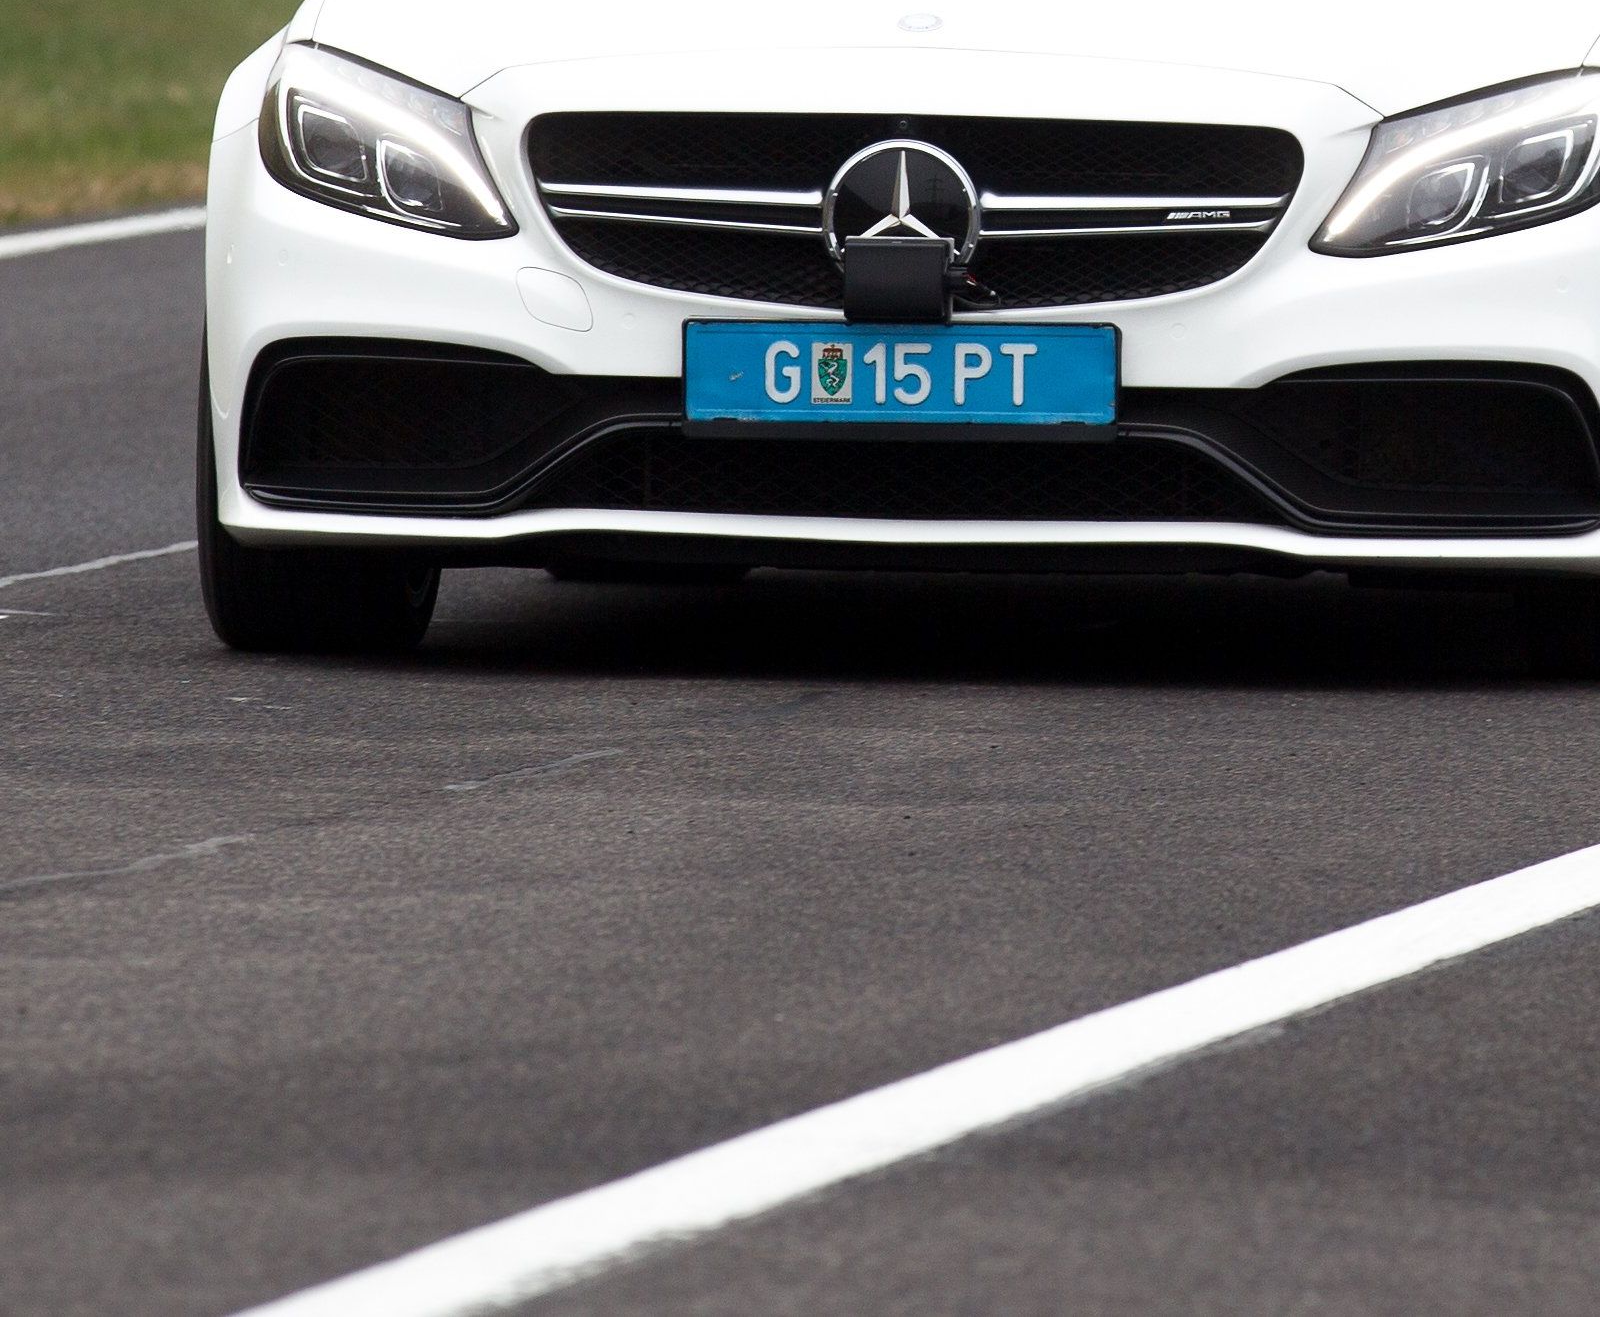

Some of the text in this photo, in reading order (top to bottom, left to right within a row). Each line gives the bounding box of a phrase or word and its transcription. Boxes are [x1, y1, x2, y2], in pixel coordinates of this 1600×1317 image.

[1186, 210, 1231, 220] AMG
[764, 340, 1037, 405] G 15 PT
